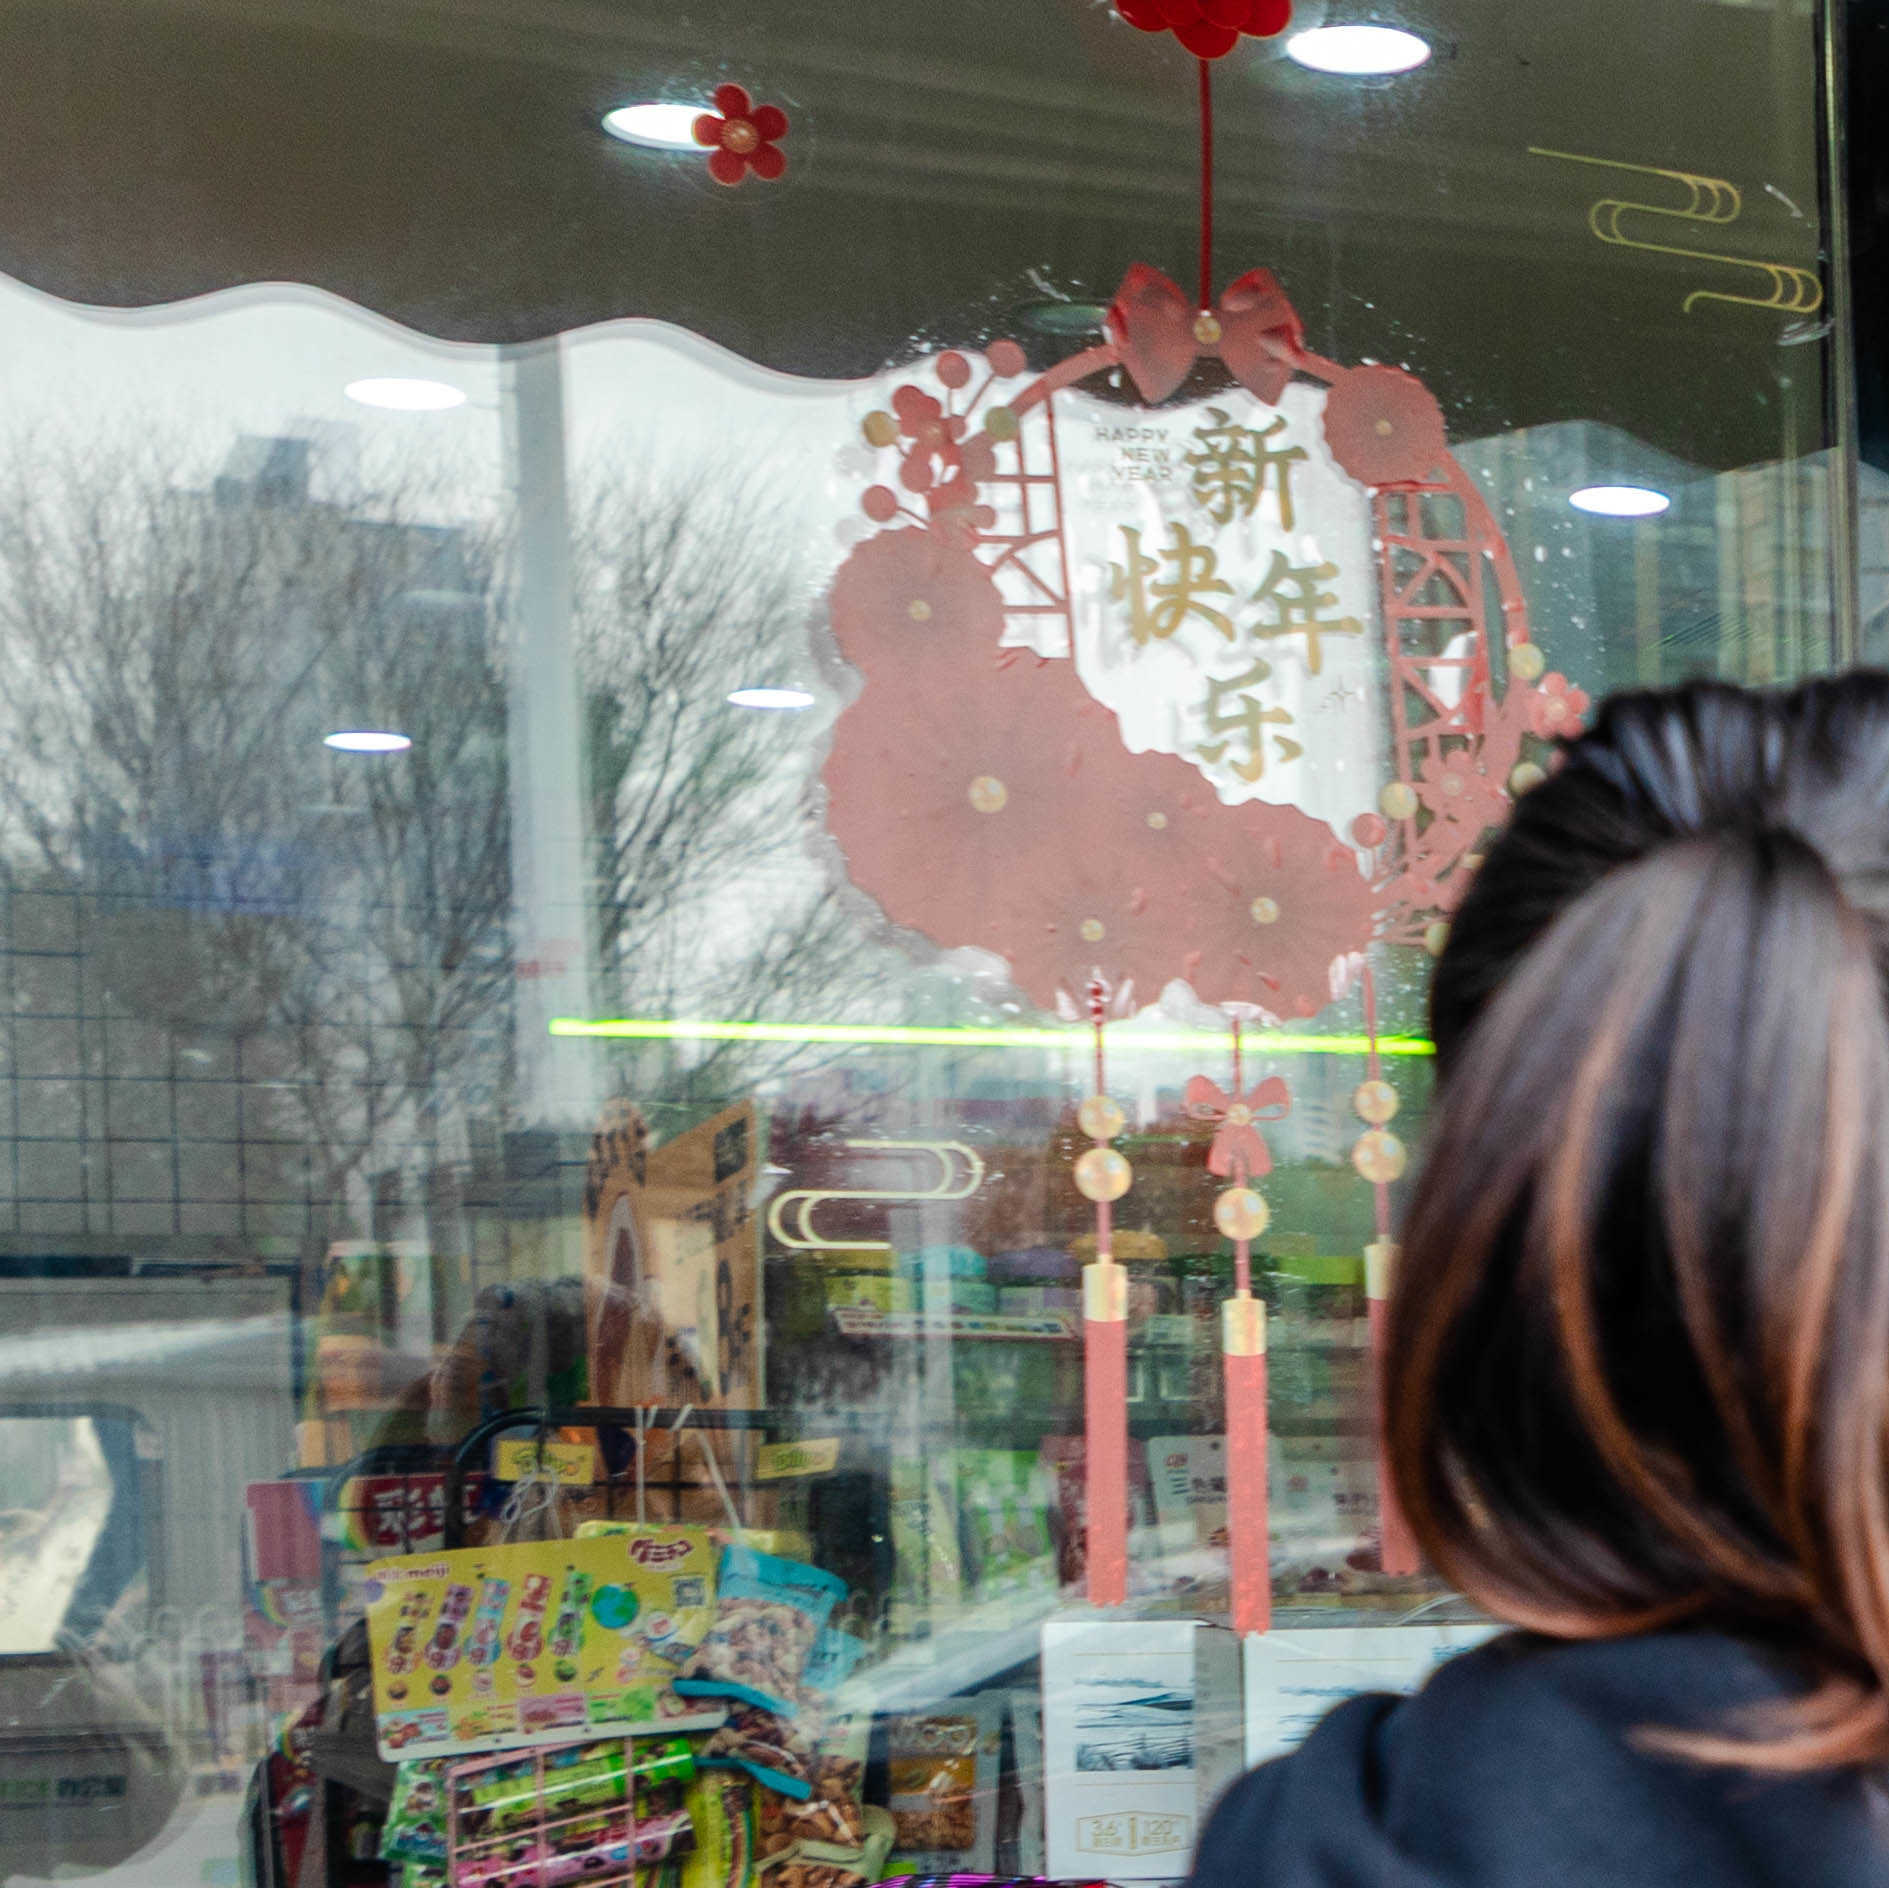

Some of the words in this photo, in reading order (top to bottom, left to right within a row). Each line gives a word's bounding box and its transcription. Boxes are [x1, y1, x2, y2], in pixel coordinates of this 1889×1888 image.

[1095, 427, 1171, 443] HAPPY
[1121, 448, 1171, 462] NEW
[1113, 467, 1173, 481] YEAR
[1105, 407, 1364, 783] 新年快乐
